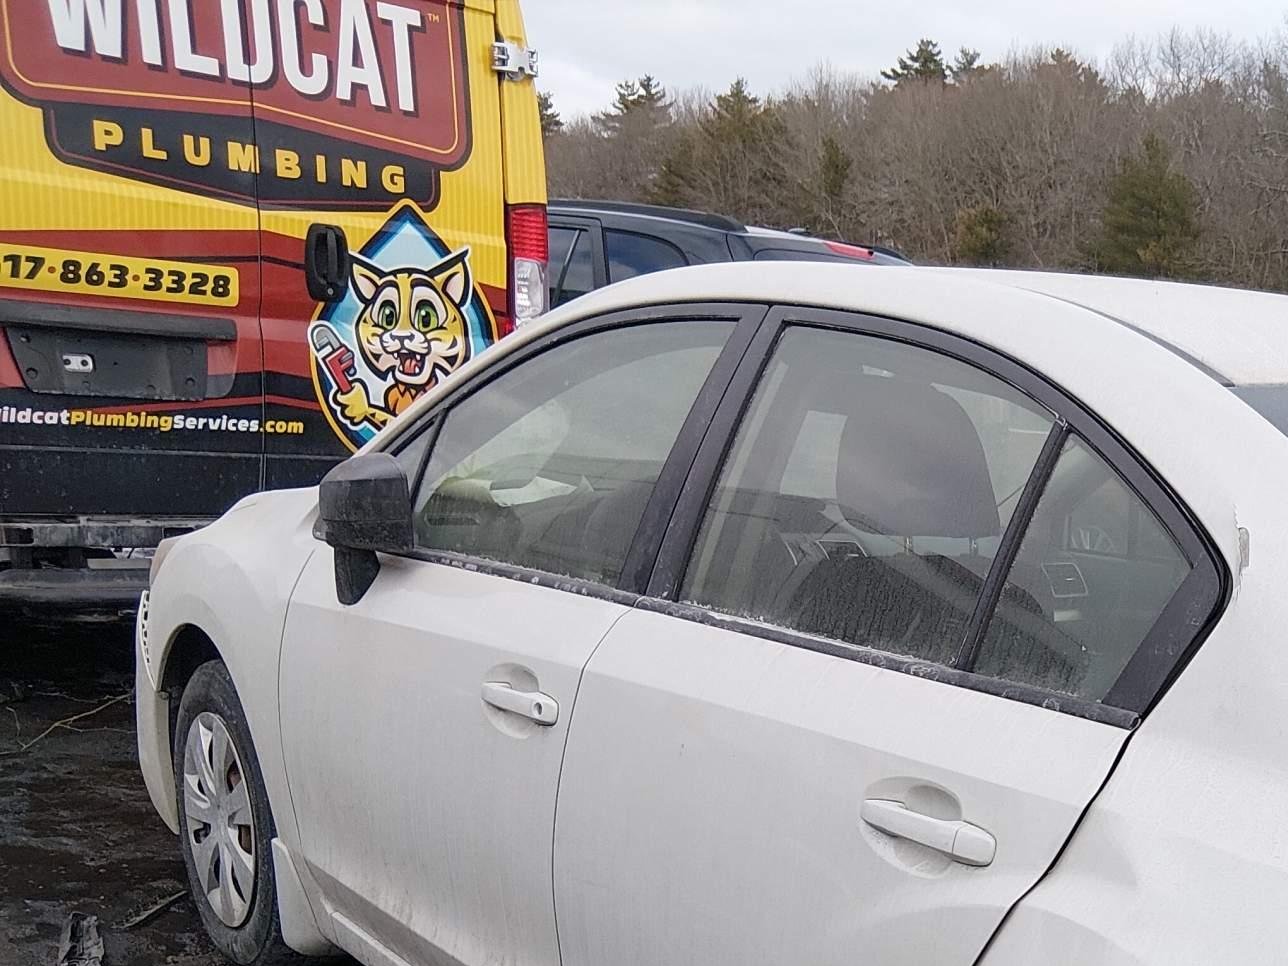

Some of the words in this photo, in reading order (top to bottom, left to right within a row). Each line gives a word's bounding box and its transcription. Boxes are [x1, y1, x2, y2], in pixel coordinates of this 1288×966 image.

[47, 0, 423, 113] WILDCAT
[91, 119, 406, 195] PLUMBING
[0, 406, 305, 434] ildcatPlumbingServices.com
